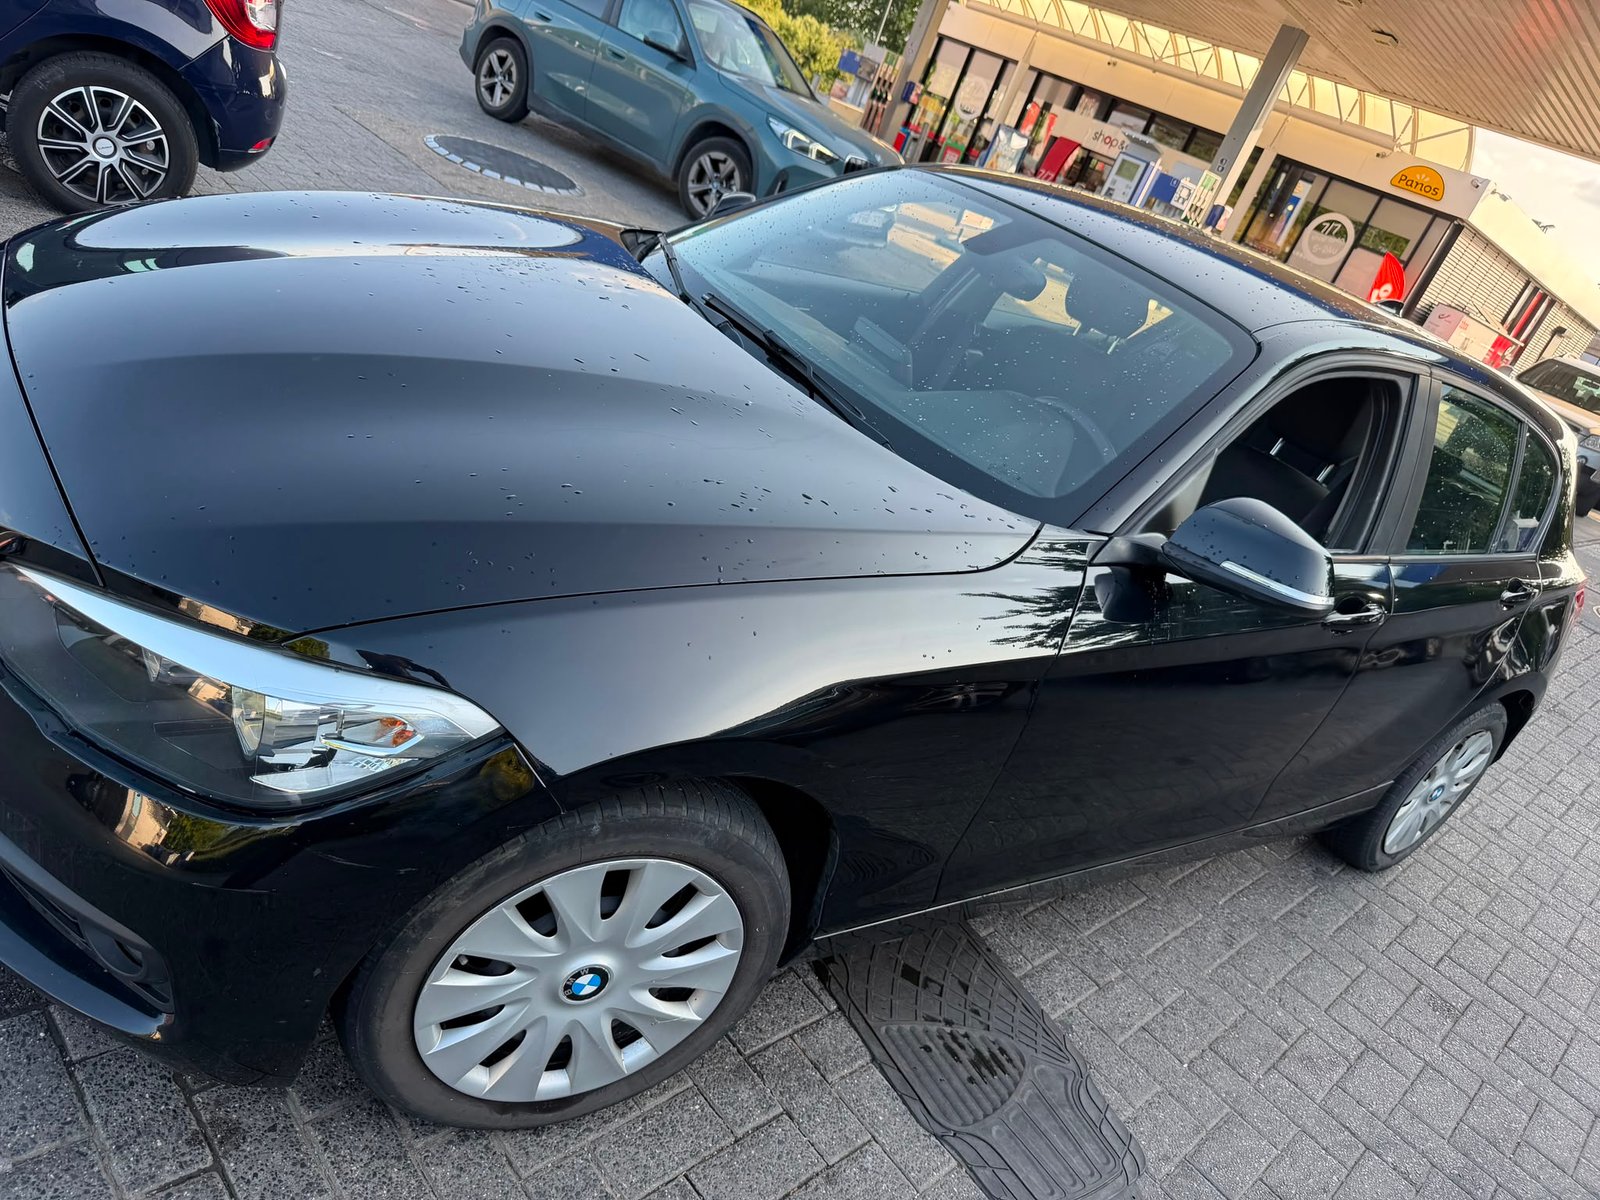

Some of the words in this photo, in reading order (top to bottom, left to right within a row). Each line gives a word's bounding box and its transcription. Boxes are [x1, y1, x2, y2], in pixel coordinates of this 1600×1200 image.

[1397, 173, 1440, 196] Panos
[1320, 222, 1342, 236] 7/7
[564, 968, 590, 996] BMW
